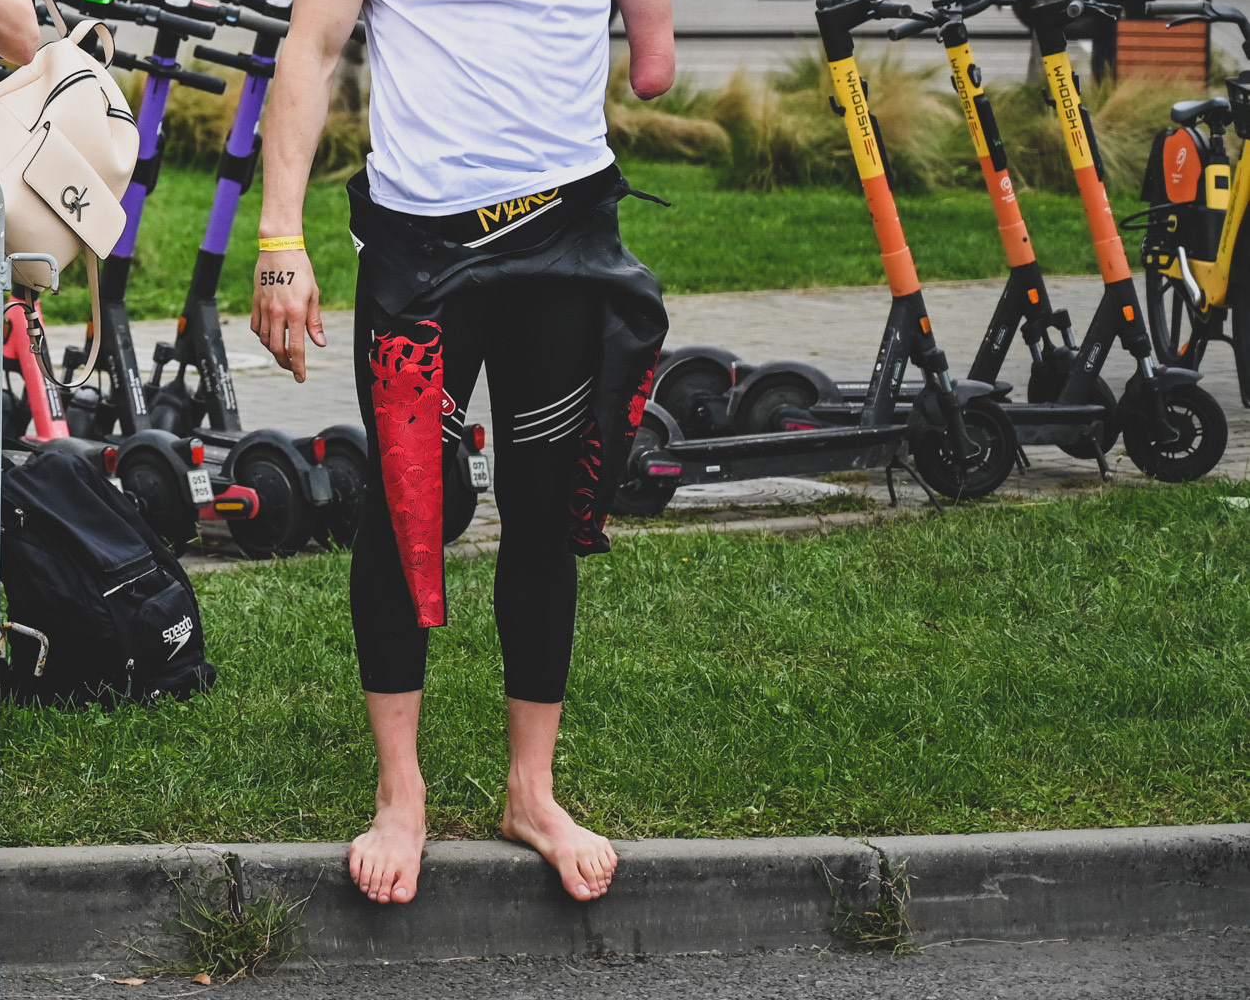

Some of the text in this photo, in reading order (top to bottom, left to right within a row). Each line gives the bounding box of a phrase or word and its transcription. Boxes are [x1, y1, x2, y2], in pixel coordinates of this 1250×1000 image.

[846, 70, 871, 138] WHOOSH
[950, 58, 974, 120] WHOOSH
[1053, 65, 1079, 129] WHOOSH
[260, 271, 295, 286] 5547
[162, 614, 193, 645] speedo
